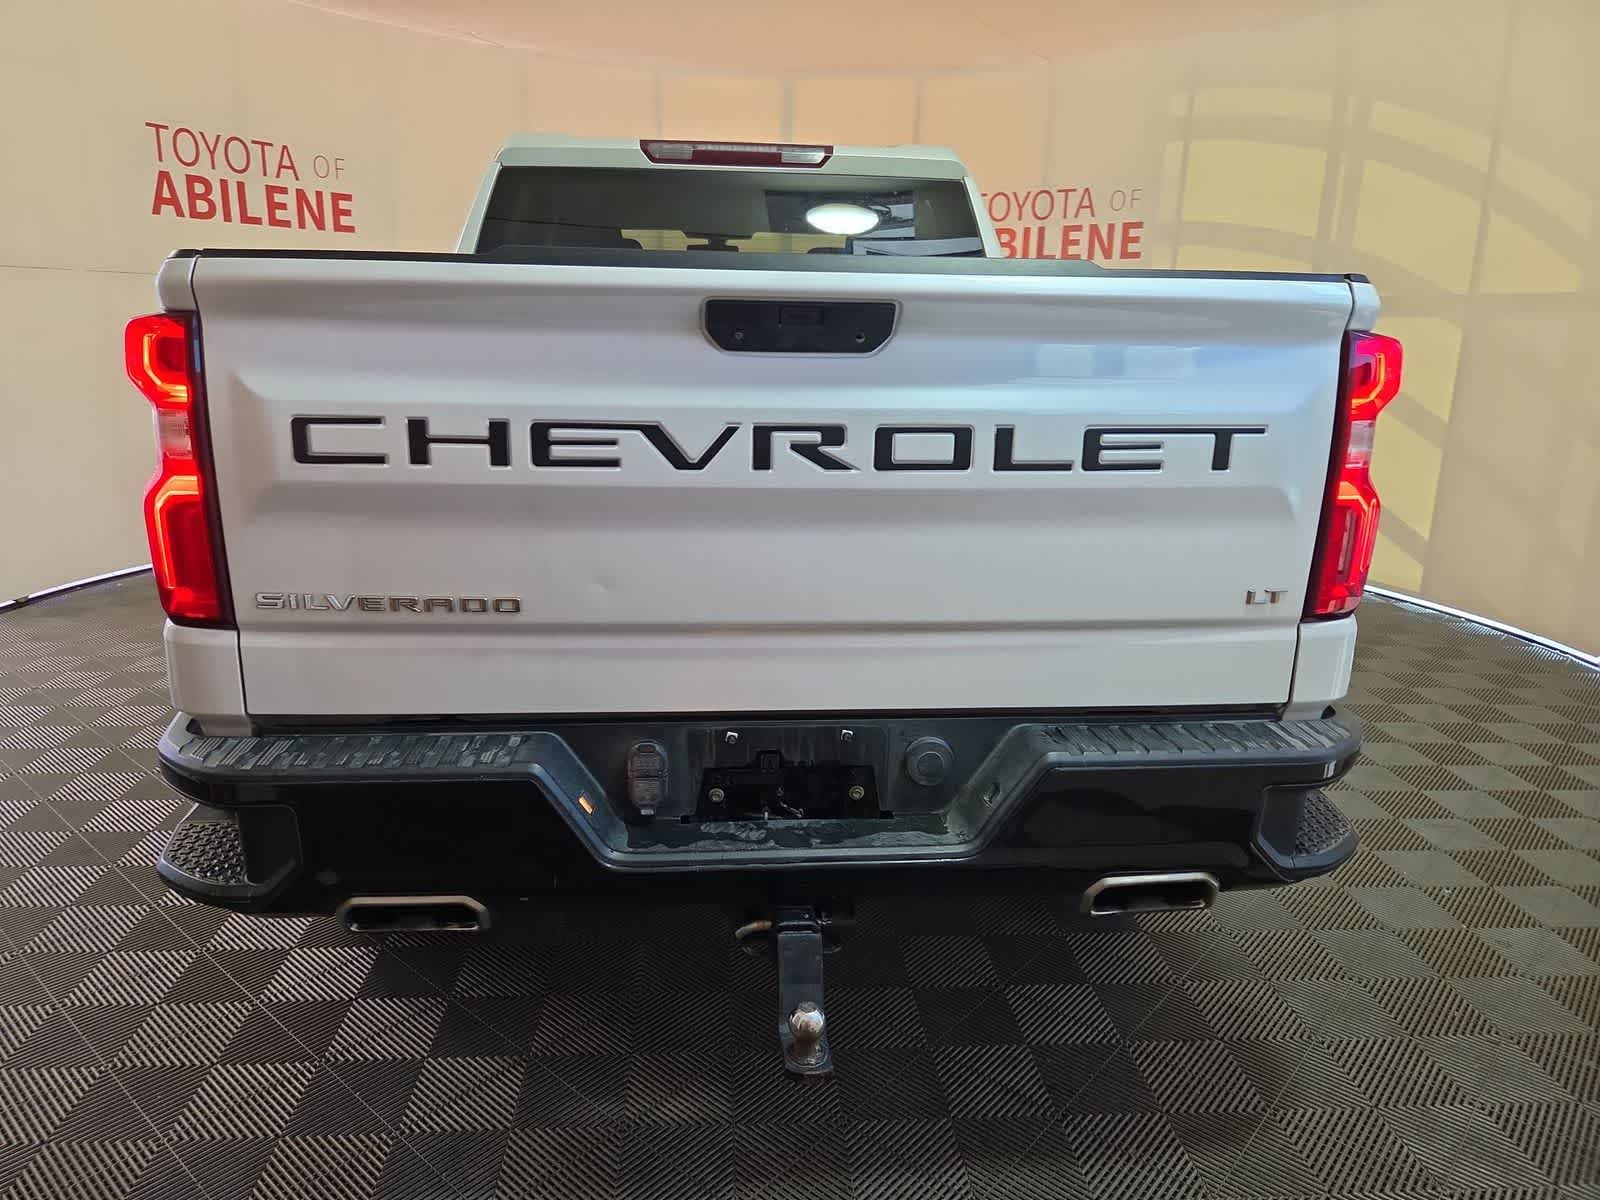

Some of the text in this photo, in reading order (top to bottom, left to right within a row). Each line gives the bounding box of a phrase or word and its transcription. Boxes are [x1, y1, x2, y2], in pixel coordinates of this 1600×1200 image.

[145, 122, 345, 181] TOYOTA OF
[152, 169, 356, 233] ABILENE
[980, 187, 1143, 222] OYOTA OF
[995, 221, 1144, 260] BILENE
[291, 415, 1267, 472] CHEVROLET
[255, 592, 522, 613] SILVERADO
[1245, 586, 1288, 605] LT
